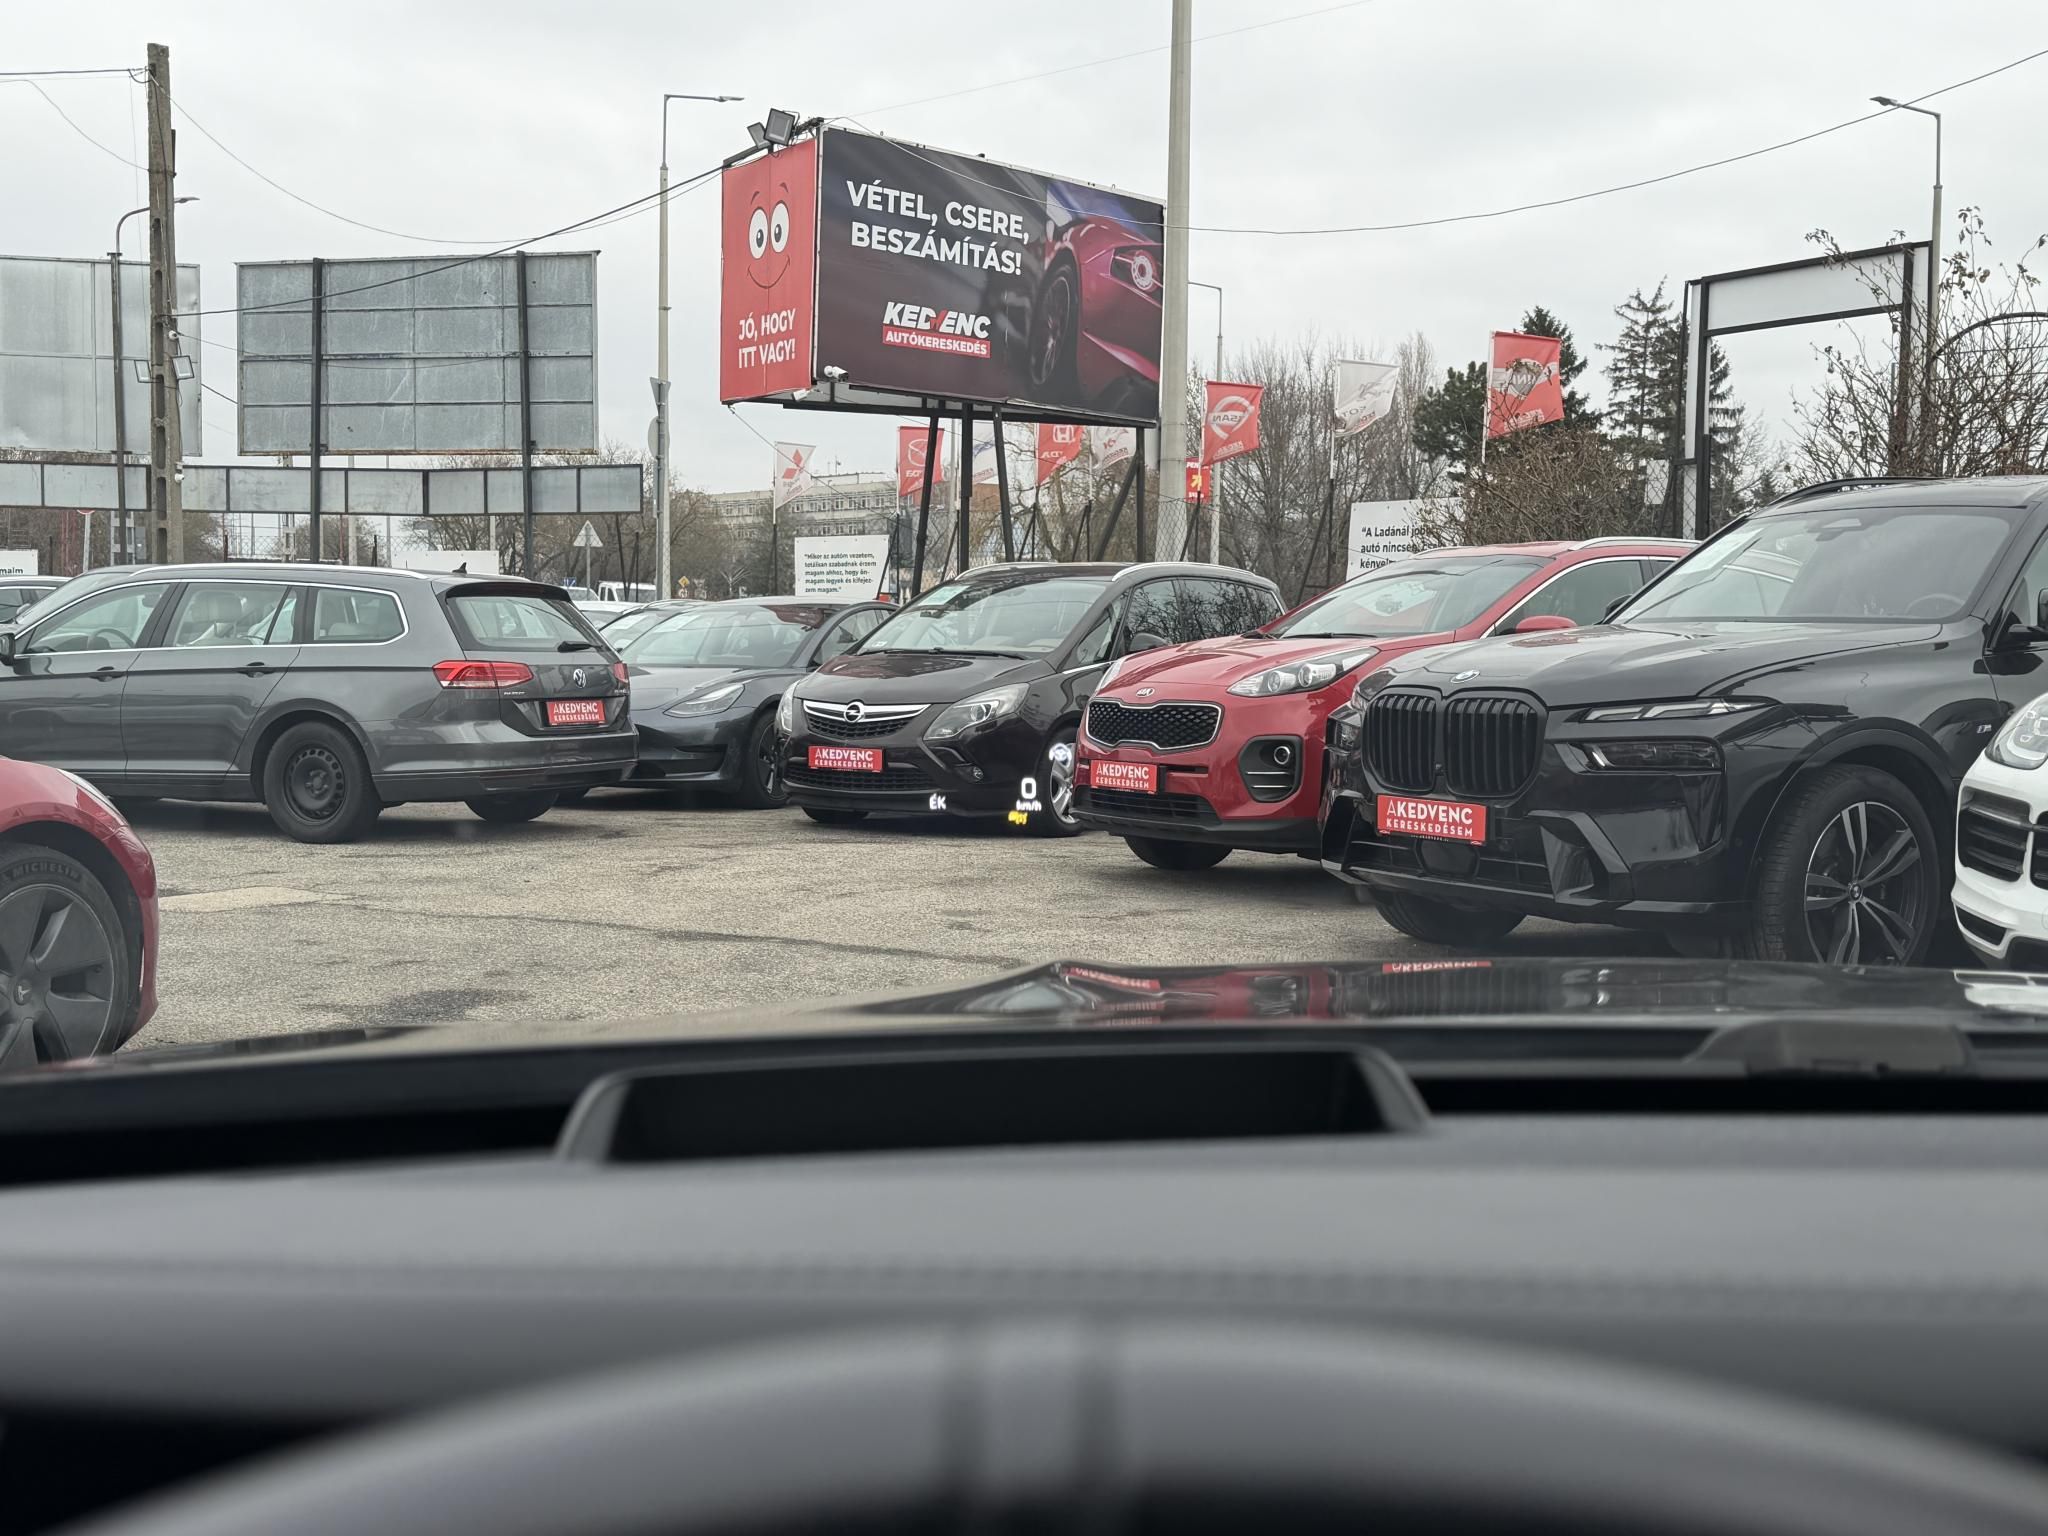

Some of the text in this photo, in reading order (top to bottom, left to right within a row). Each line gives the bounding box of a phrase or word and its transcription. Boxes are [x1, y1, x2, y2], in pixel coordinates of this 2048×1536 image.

[847, 179, 1029, 244] VÉTEL, CSERE,
[851, 221, 1022, 275] BESZÁMÍTÁS!
[738, 308, 796, 341] JÓ, HOGY
[886, 330, 987, 354] AUTÓKERESKEDÉS
[738, 338, 796, 368] ITT VAGY!
[1374, 525, 1410, 537] Ladánál
[1411, 525, 1430, 539] job
[1360, 542, 1381, 553] autó
[1360, 558, 1389, 569] kényel
[929, 793, 947, 810] ÉK
[1016, 799, 1042, 811] km/h
[1386, 818, 1473, 837] KERESKEDÉSEM
[12, 861, 81, 880] MICHELIN
